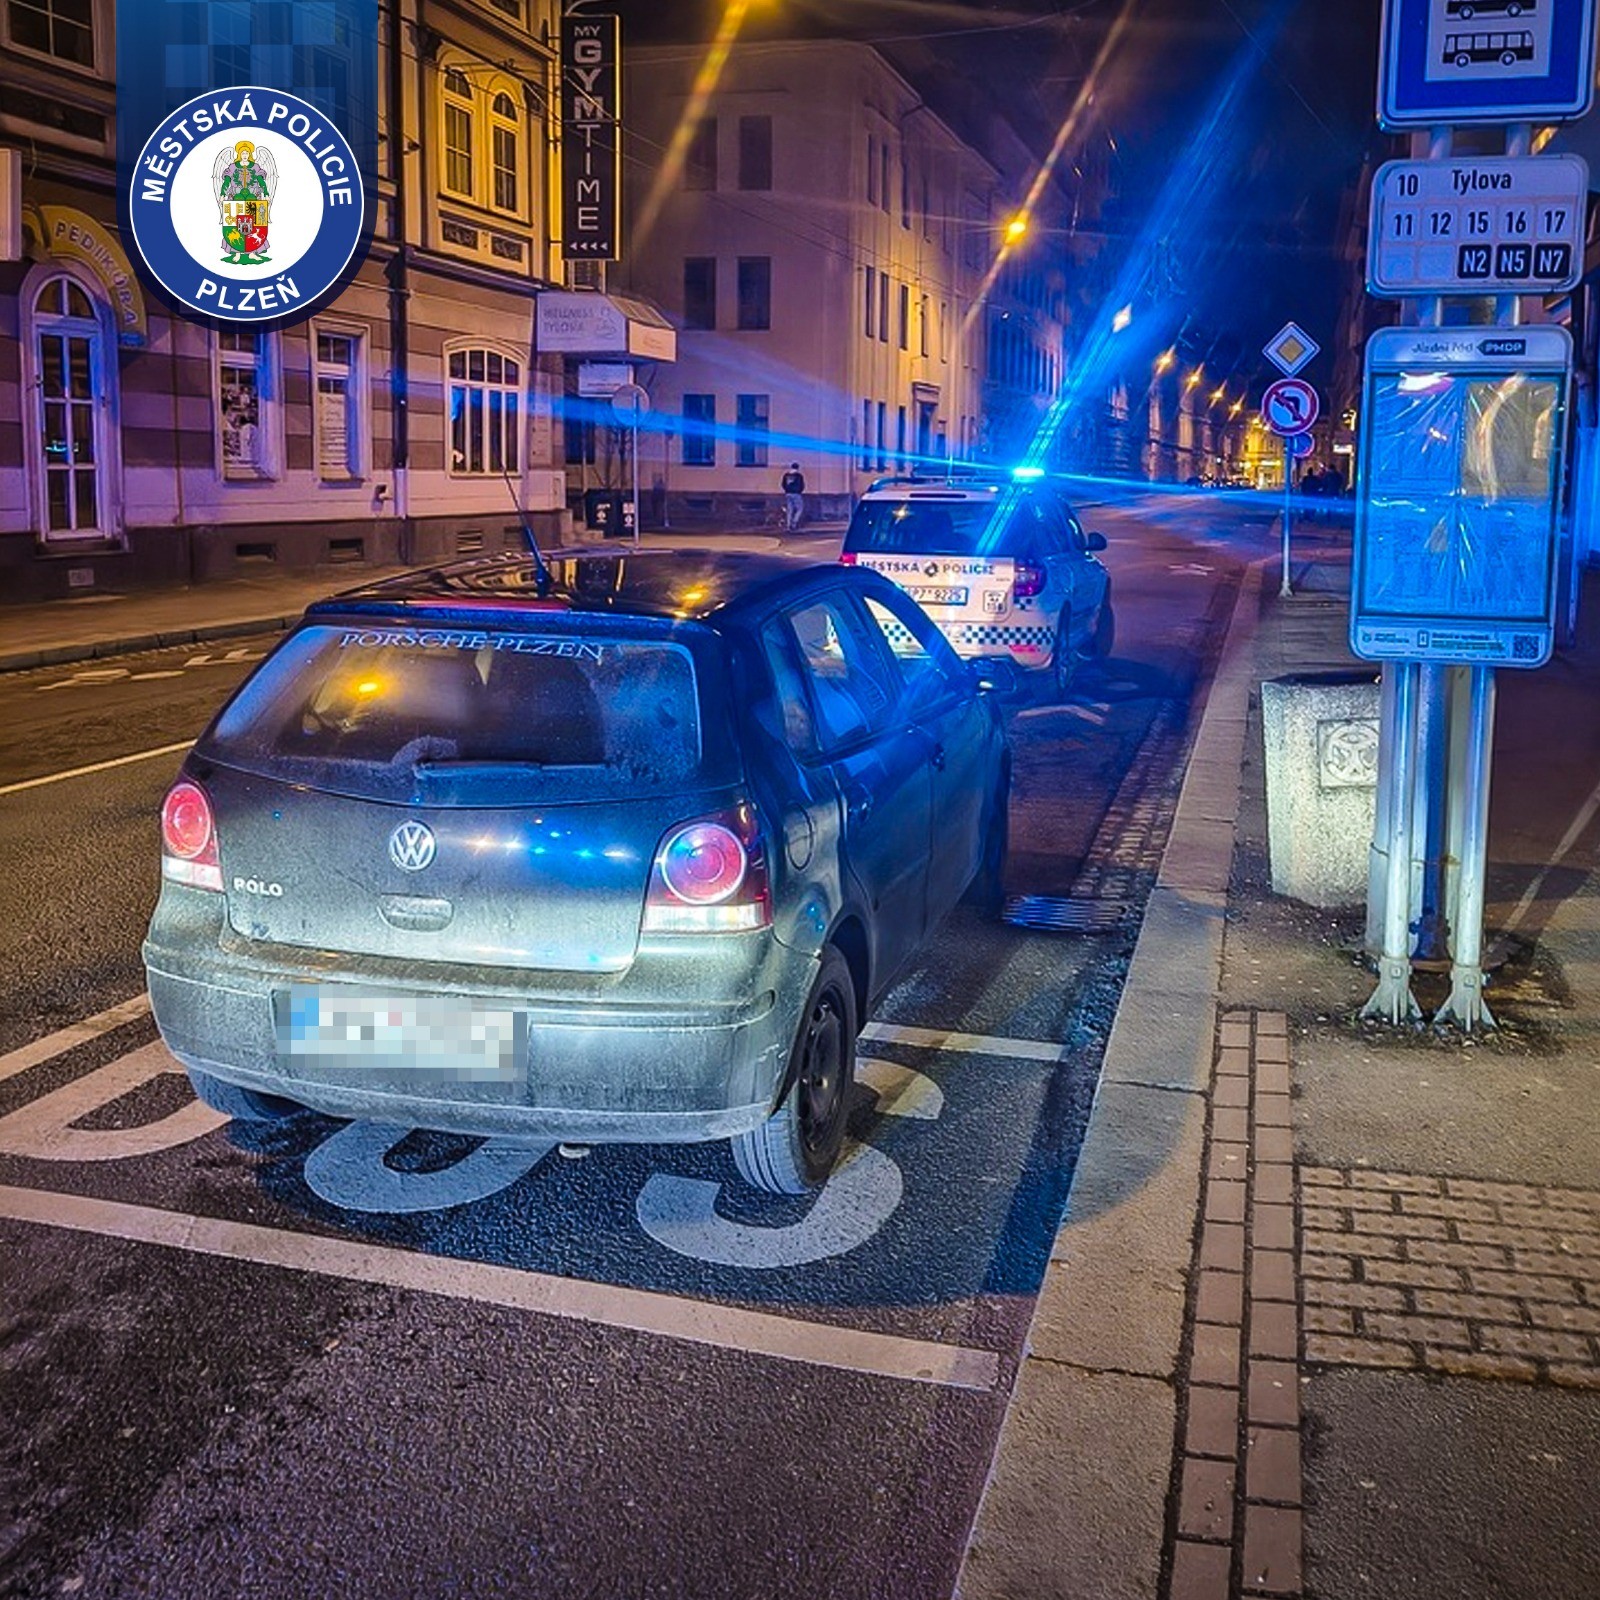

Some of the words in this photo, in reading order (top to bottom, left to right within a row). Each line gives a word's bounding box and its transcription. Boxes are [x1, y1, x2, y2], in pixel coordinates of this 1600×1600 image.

[574, 26, 600, 37] MY
[1398, 174, 1419, 196] 10
[1452, 169, 1512, 196] Tylova
[1394, 214, 1413, 236] 11
[1431, 213, 1452, 235] 12
[1468, 212, 1489, 234] 15
[1506, 211, 1527, 233] 16
[1544, 210, 1566, 233] 17
[1463, 251, 1486, 273] N2
[1501, 251, 1525, 273] N5
[1539, 250, 1564, 273] N7
[340, 631, 488, 649] PORSCHE
[233, 876, 284, 898] POLO
